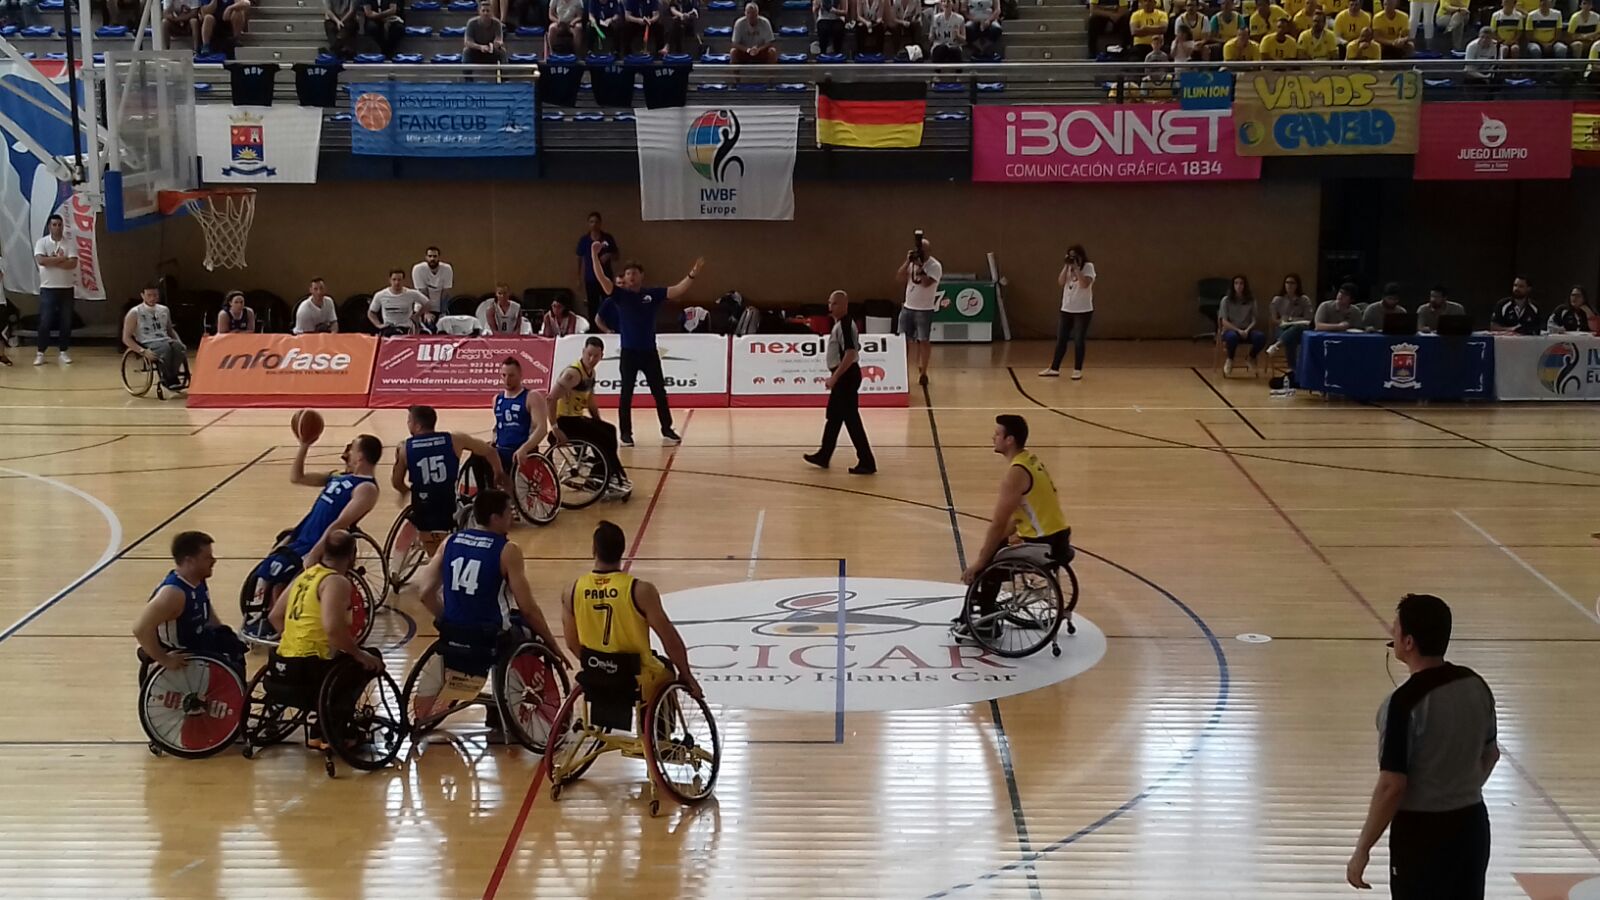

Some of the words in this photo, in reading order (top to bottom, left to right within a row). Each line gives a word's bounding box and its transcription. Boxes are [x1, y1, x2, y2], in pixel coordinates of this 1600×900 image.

[1183, 86, 1230, 99] ILUNION
[1254, 73, 1378, 110] VAMOS
[399, 114, 487, 131] FANCLUB
[1273, 109, 1396, 149] CANELO
[1457, 149, 1490, 160] JUEGO
[1492, 148, 1528, 159] LIMPIO
[1006, 162, 1113, 177] COMUNICACIÓN
[1118, 160, 1177, 176] GRÁFICA
[1181, 160, 1222, 175] 1834
[700, 188, 737, 201] IWBF
[700, 204, 737, 216] Europe
[750, 337, 887, 357] nexglal
[218, 347, 350, 370] infofase
[664, 376, 697, 387] Bus
[504, 409, 513, 422] 6
[416, 455, 448, 485] 15
[450, 556, 482, 595] 14
[584, 588, 618, 599] PABLO
[592, 603, 614, 646] 7
[686, 644, 1018, 669] CICAR
[814, 671, 939, 682] Islands
[951, 672, 1017, 682] Car
